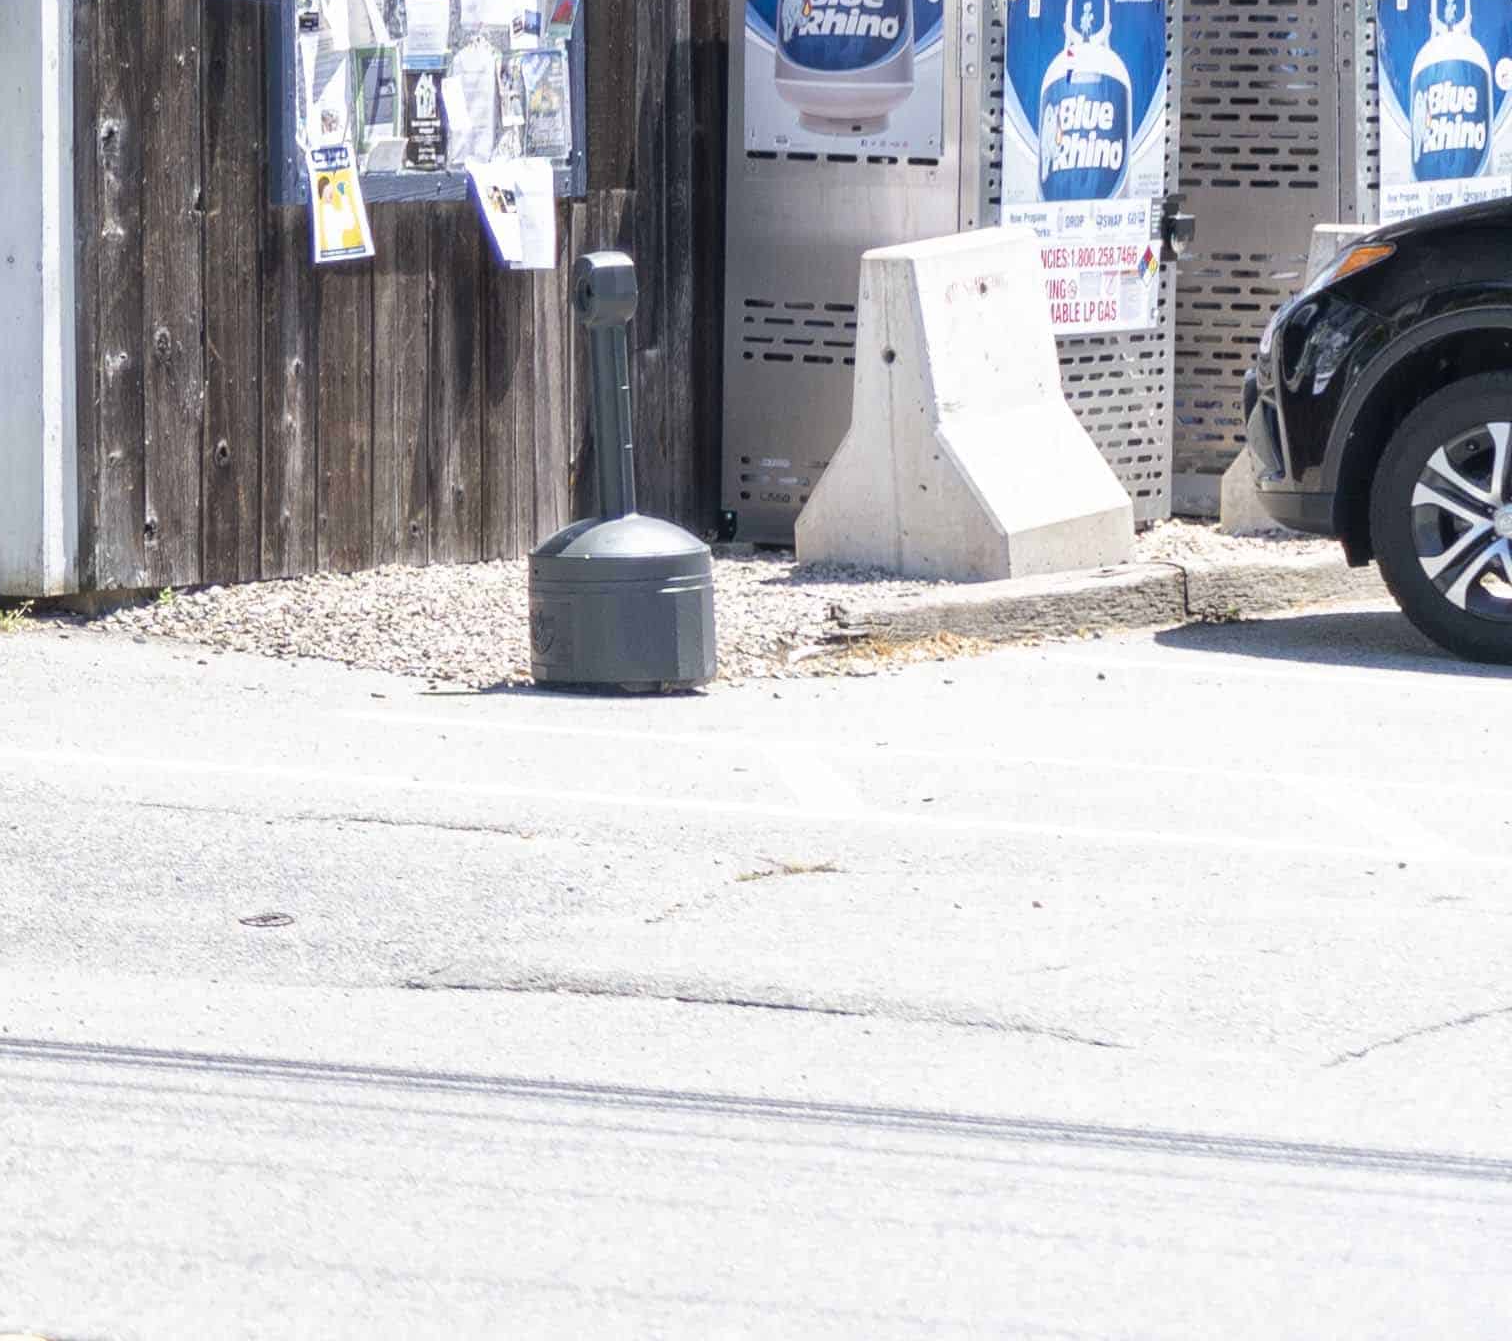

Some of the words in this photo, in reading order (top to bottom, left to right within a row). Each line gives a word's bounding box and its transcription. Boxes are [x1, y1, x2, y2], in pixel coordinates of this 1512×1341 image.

[799, 9, 899, 39] Rhino
[1060, 95, 1114, 131] Blue
[1429, 81, 1477, 115] Blue
[1053, 131, 1123, 171] Rhino
[1423, 115, 1486, 153] Rhino
[1083, 301, 1096, 322] LP
[1097, 300, 1117, 321] GAS
